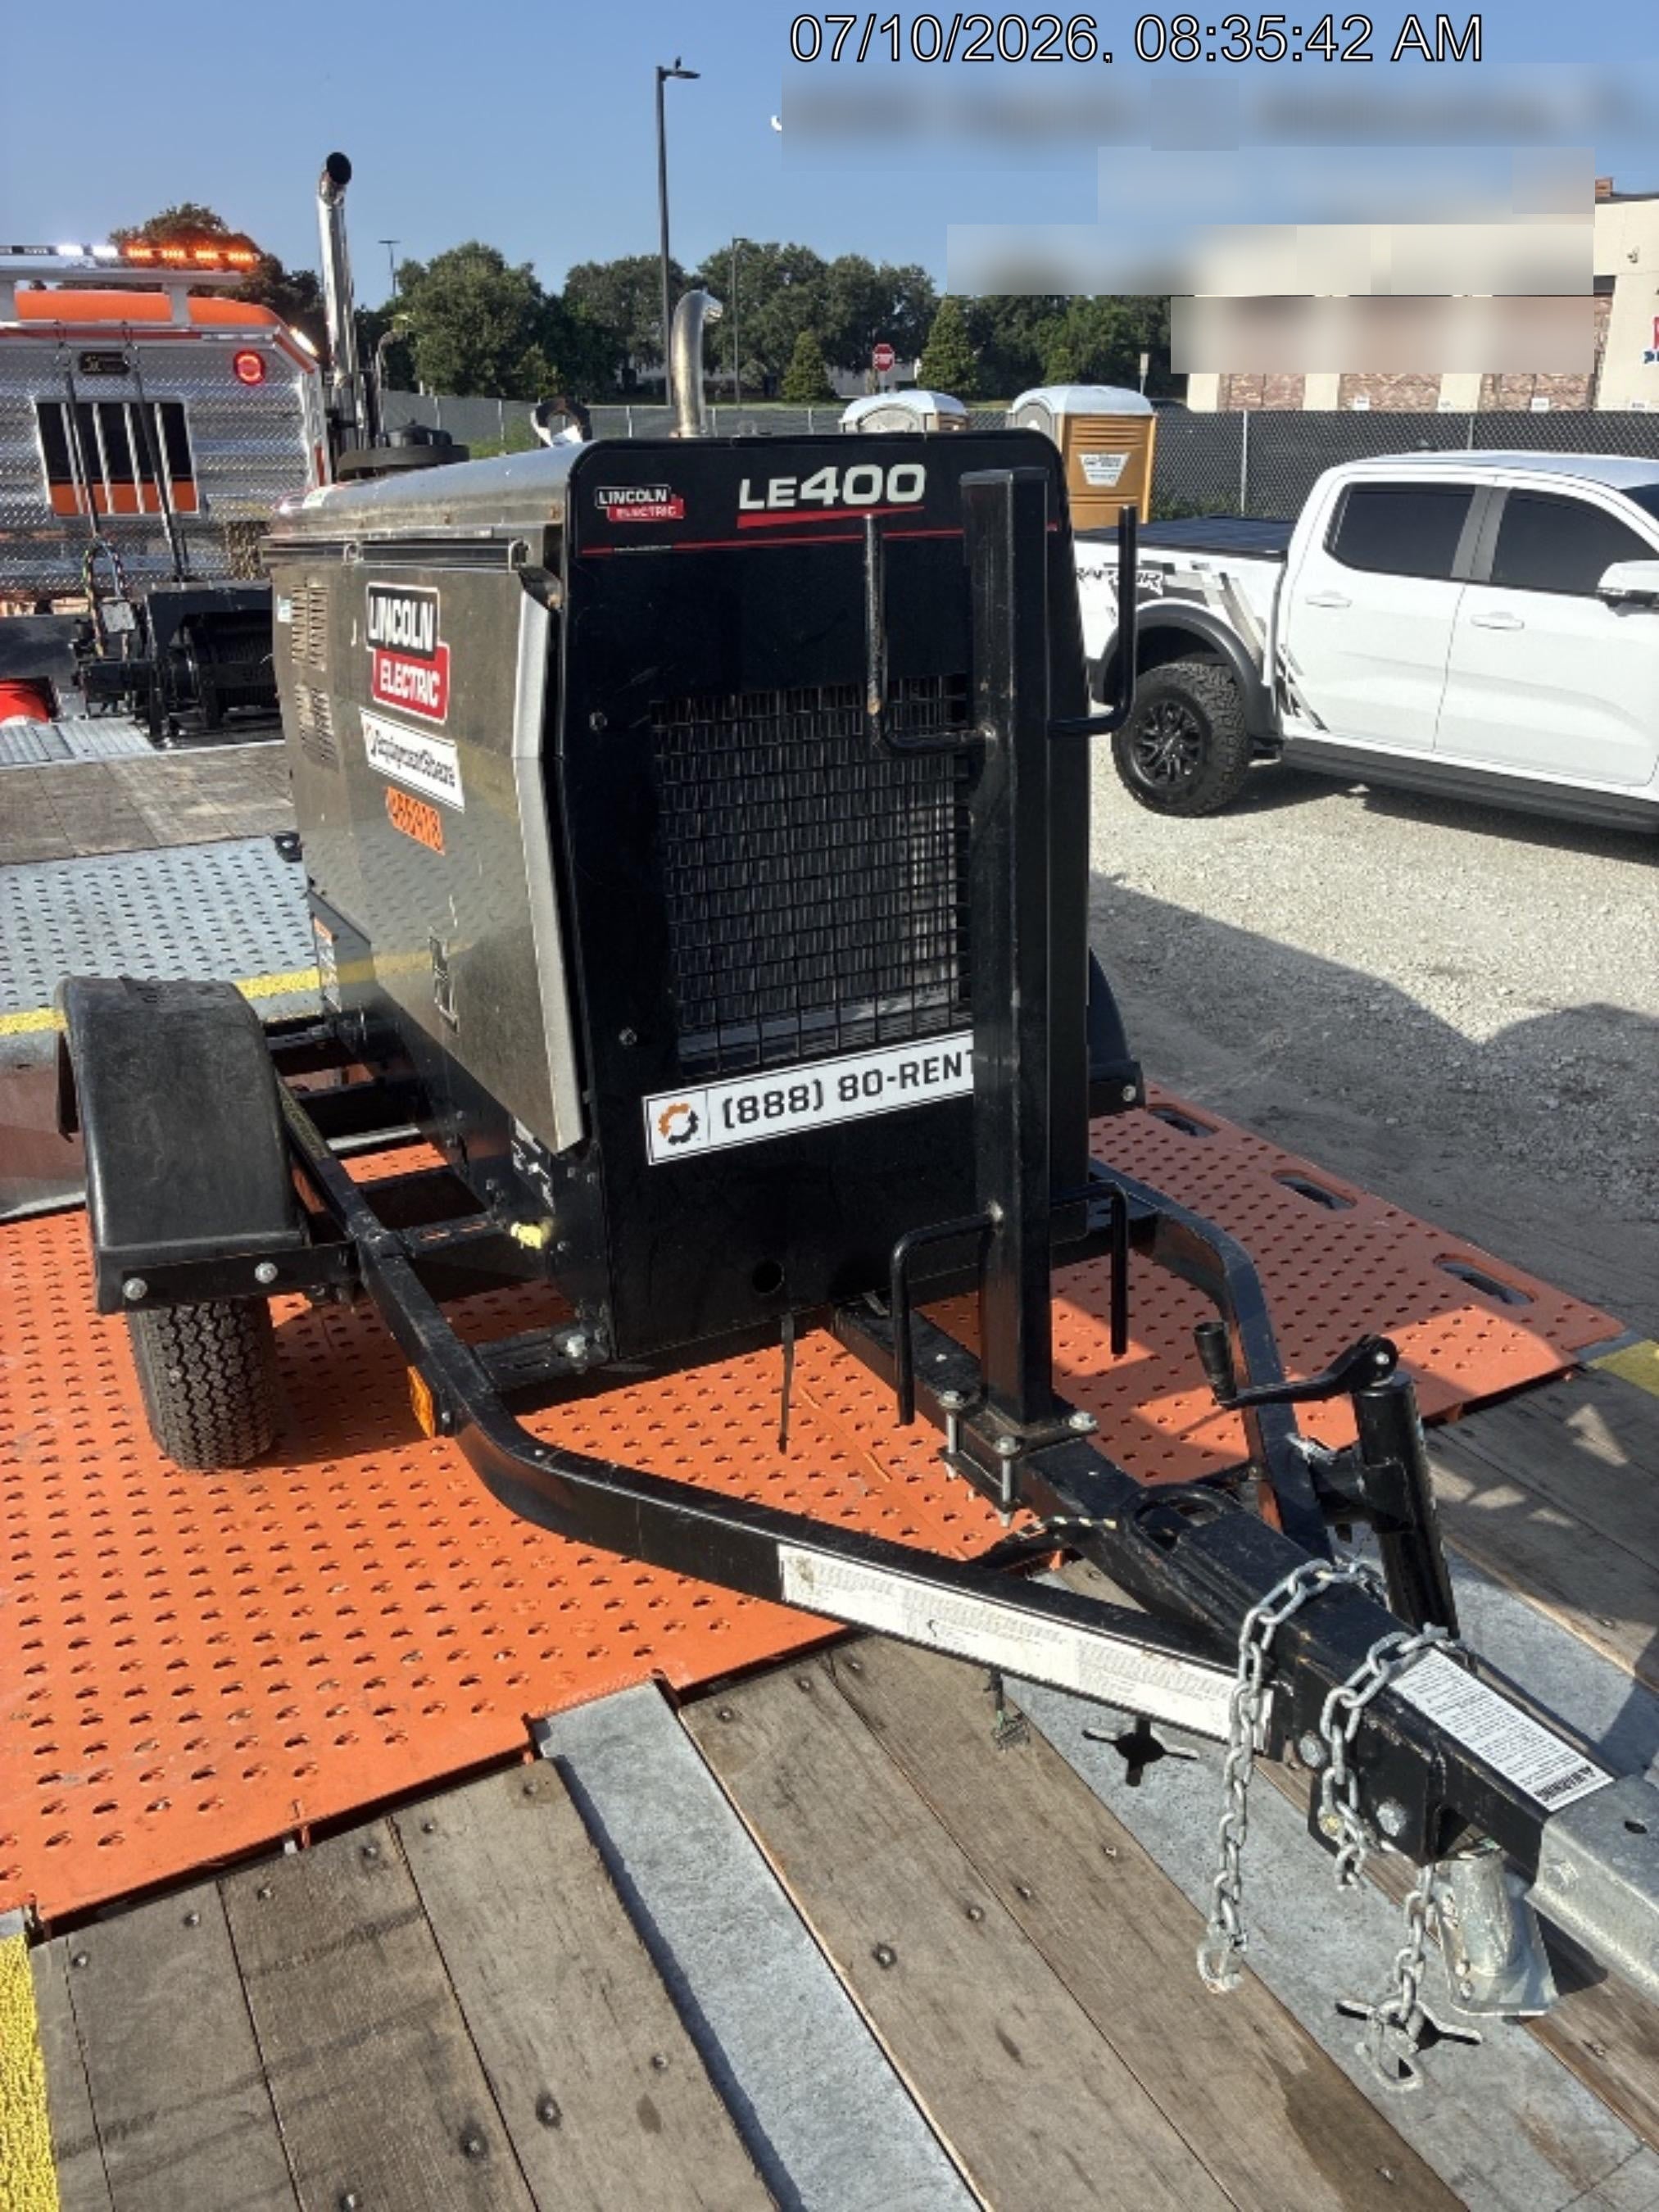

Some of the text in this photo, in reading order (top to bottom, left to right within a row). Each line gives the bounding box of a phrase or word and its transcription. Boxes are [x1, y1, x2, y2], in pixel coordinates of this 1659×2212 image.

[598, 488, 668, 505] LINCOLN
[739, 464, 927, 510] LE400
[615, 505, 678, 519] ELECTRIC
[369, 595, 434, 652] LINCOLN
[380, 658, 441, 709] ELECTRIC
[722, 1078, 824, 1130] (888)
